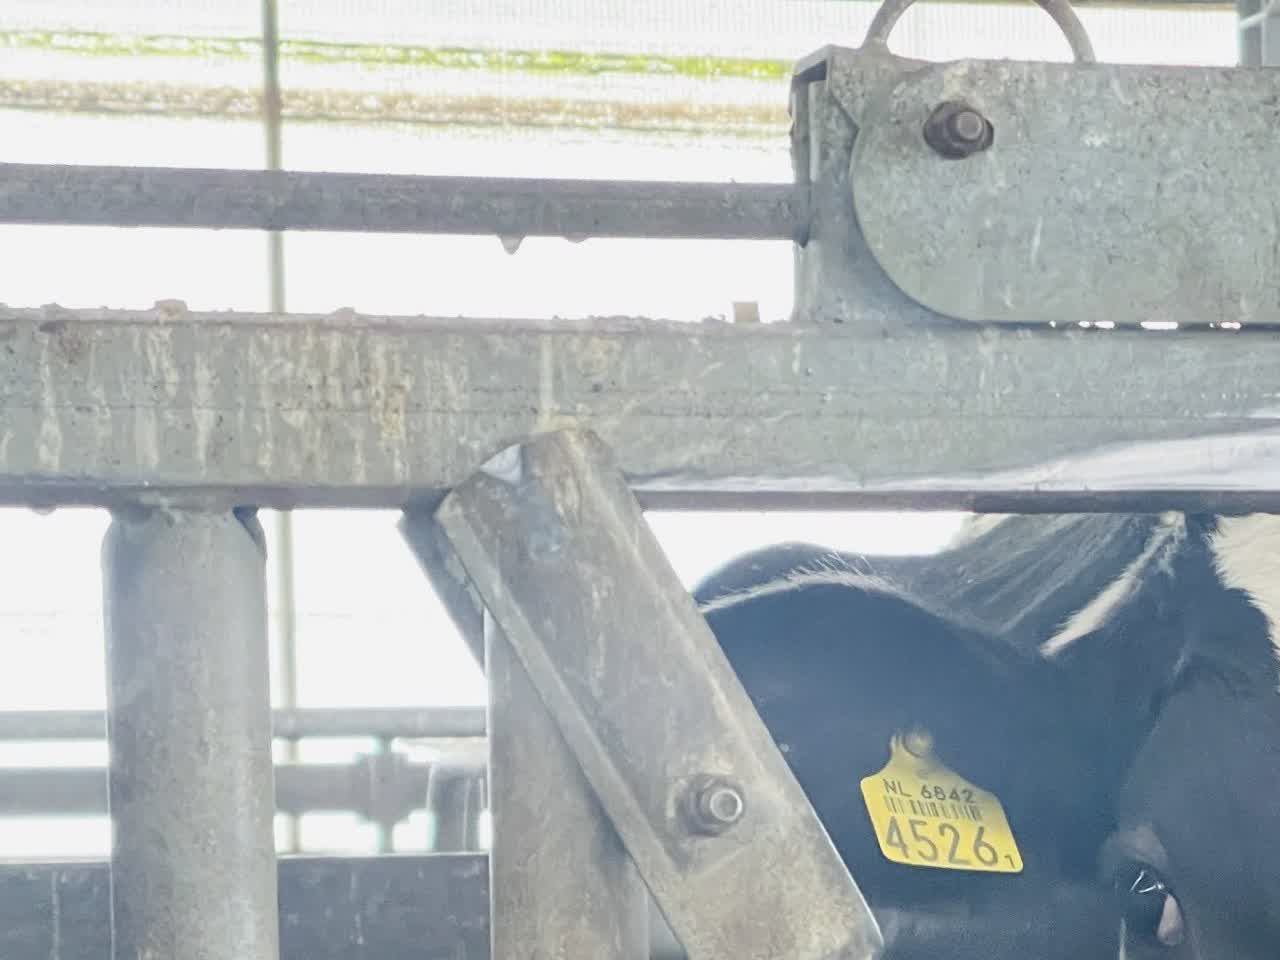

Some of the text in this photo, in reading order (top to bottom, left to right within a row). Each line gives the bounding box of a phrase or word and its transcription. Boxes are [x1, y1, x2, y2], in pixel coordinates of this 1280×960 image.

[883, 778, 976, 804] NL 6842
[886, 816, 998, 866] 4526
